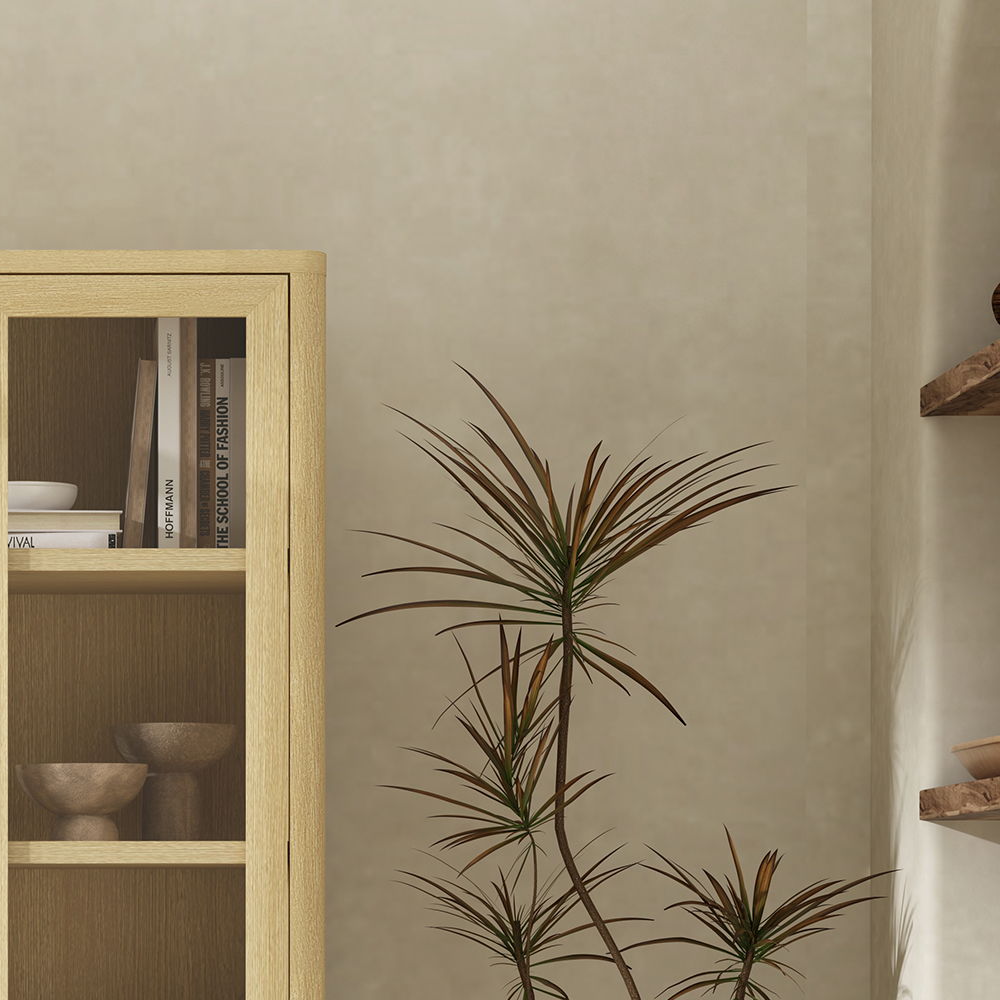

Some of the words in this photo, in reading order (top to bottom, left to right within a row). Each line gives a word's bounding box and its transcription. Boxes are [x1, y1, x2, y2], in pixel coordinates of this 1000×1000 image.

[200, 378, 211, 408] ROWLING
[216, 396, 229, 450] FASHION
[216, 452, 229, 470] OF
[165, 478, 174, 539] HOFFMANN
[216, 472, 229, 523] SCHOOL
[216, 526, 229, 548] THE
